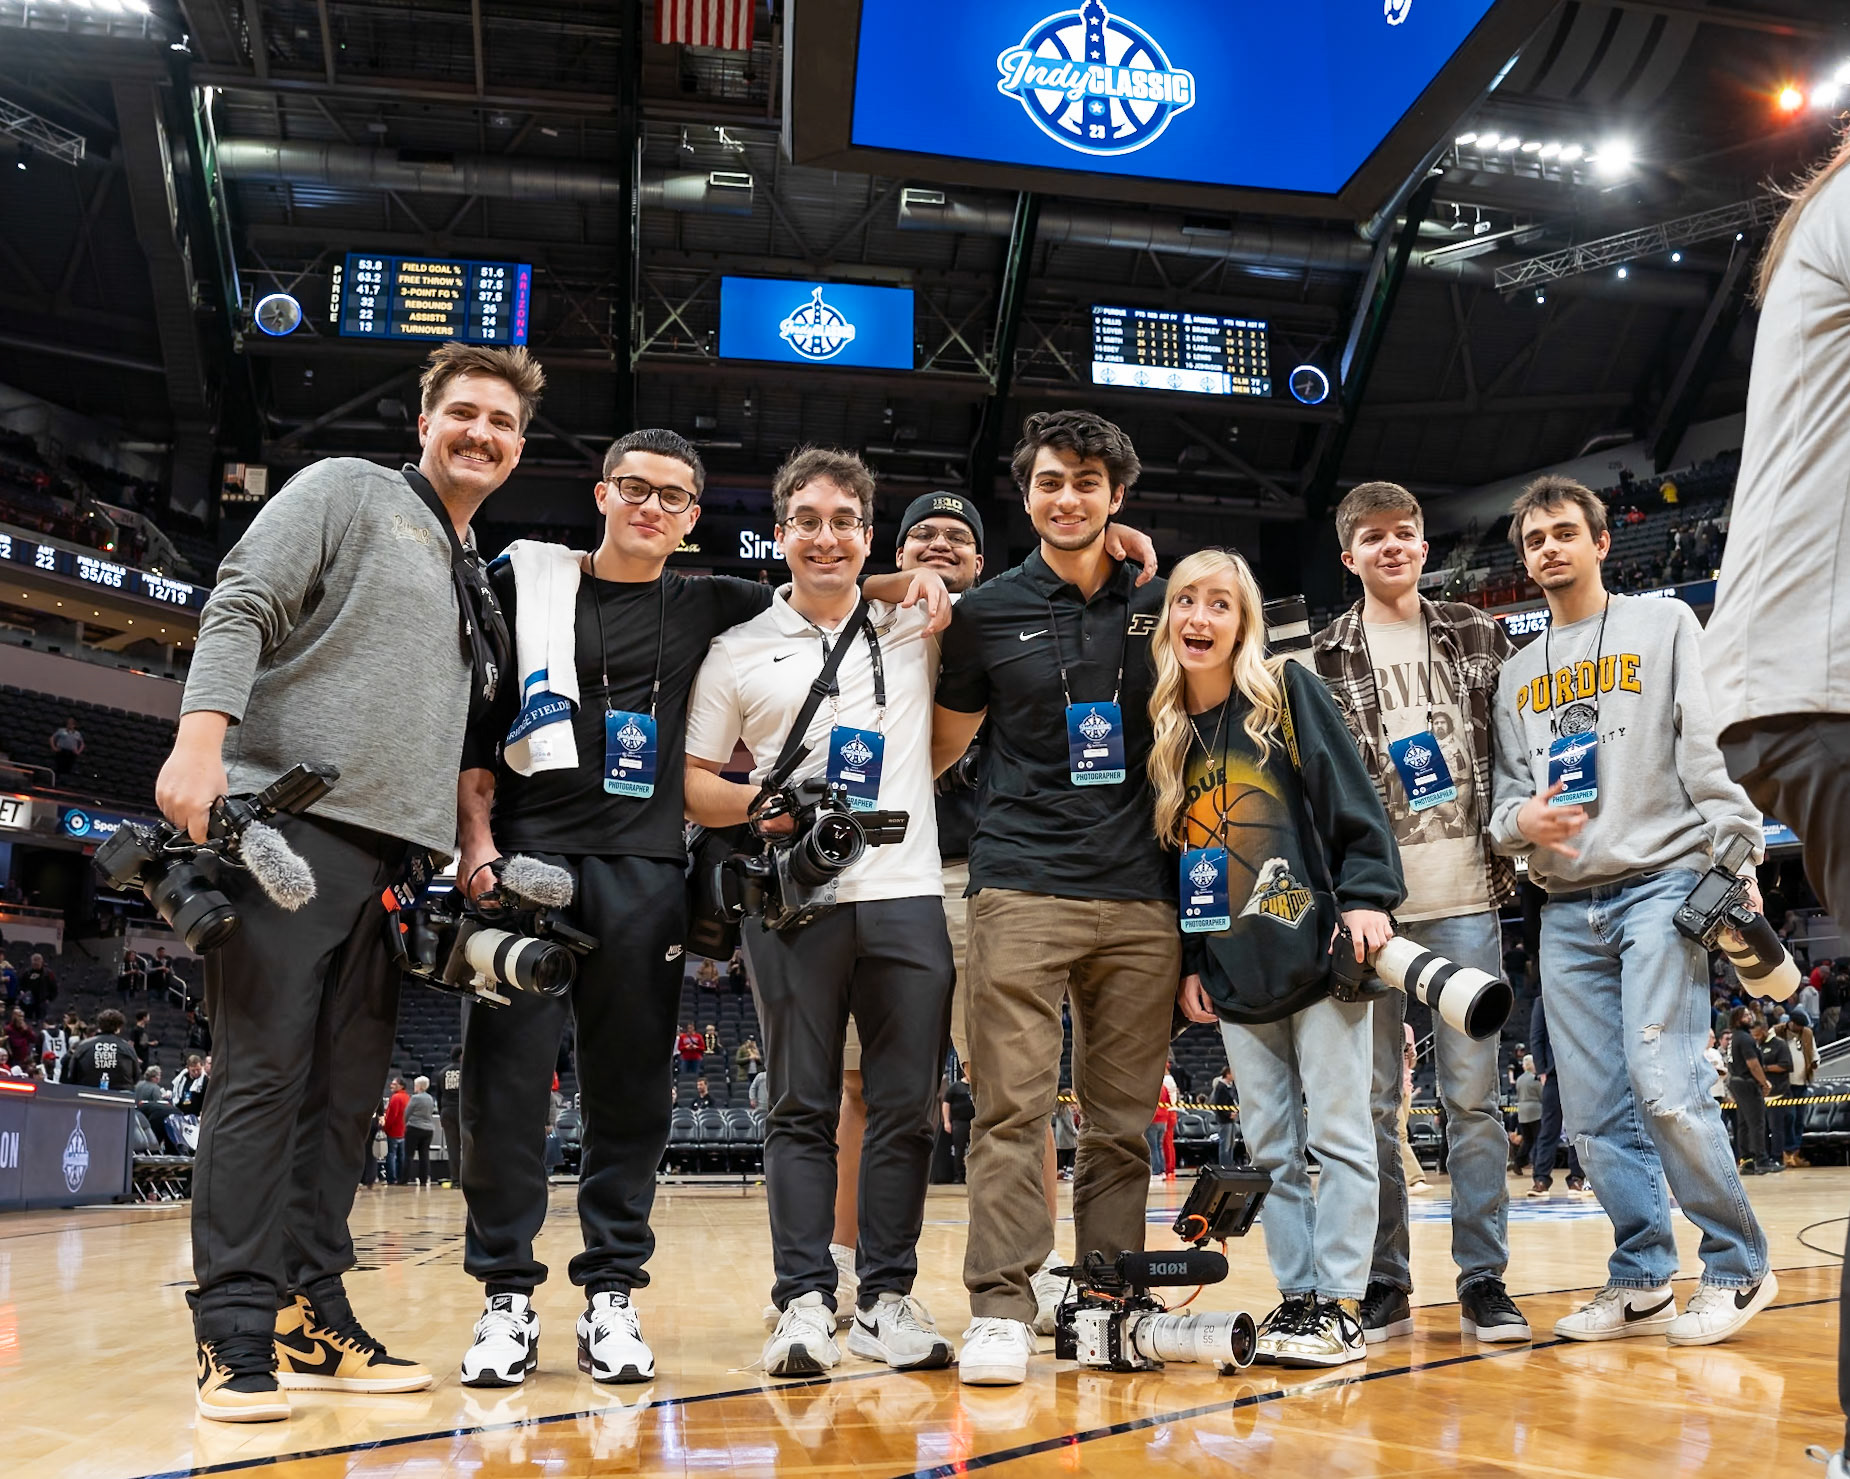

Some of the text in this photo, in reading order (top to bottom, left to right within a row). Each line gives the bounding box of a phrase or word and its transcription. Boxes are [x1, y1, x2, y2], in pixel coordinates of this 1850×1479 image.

[358, 260, 504, 278] 53.8 FIELD GOAL % 51.6
[357, 272, 503, 290] 63.2 FREE THROW % 87.5
[330, 265, 342, 322] PURDUE
[356, 285, 502, 302] 41.7 3-POINT FG % 37.5
[360, 297, 497, 314] 32 REBOUNDS 26
[516, 272, 528, 336] ARIZONA
[359, 309, 496, 326] 22 ASSISTS 24
[359, 321, 495, 338] 13 TURNOVERS 13
[38, 545, 55, 556] AST
[35, 554, 54, 570] 22
[77, 556, 126, 575] FIELD GOALS
[80, 566, 122, 588] 35/65
[142, 573, 192, 594] FREE THROWS
[149, 584, 186, 605] 12/19
[1505, 610, 1549, 624] FIELD GOALS
[1509, 619, 1547, 635] 32/62
[1516, 653, 1641, 720] PURDUE
[1076, 772, 1120, 780] PHOTOGRAPHER
[609, 781, 649, 793] PHOTOGRAPHER
[1415, 788, 1453, 806] PHOTOGRAPHER
[1552, 791, 1593, 804] PHOTOGRAPHER
[94, 820, 120, 832] Spor
[1260, 888, 1313, 920] PURDUE
[1185, 918, 1226, 928] PHOTOGRAPHER
[50, 1040, 62, 1051] 15
[95, 1043, 117, 1052] CSC
[94, 1052, 116, 1060] EVENT
[95, 1060, 118, 1069] STAFF
[0, 1131, 19, 1168] ON
[1150, 1262, 1187, 1275] RØDE
